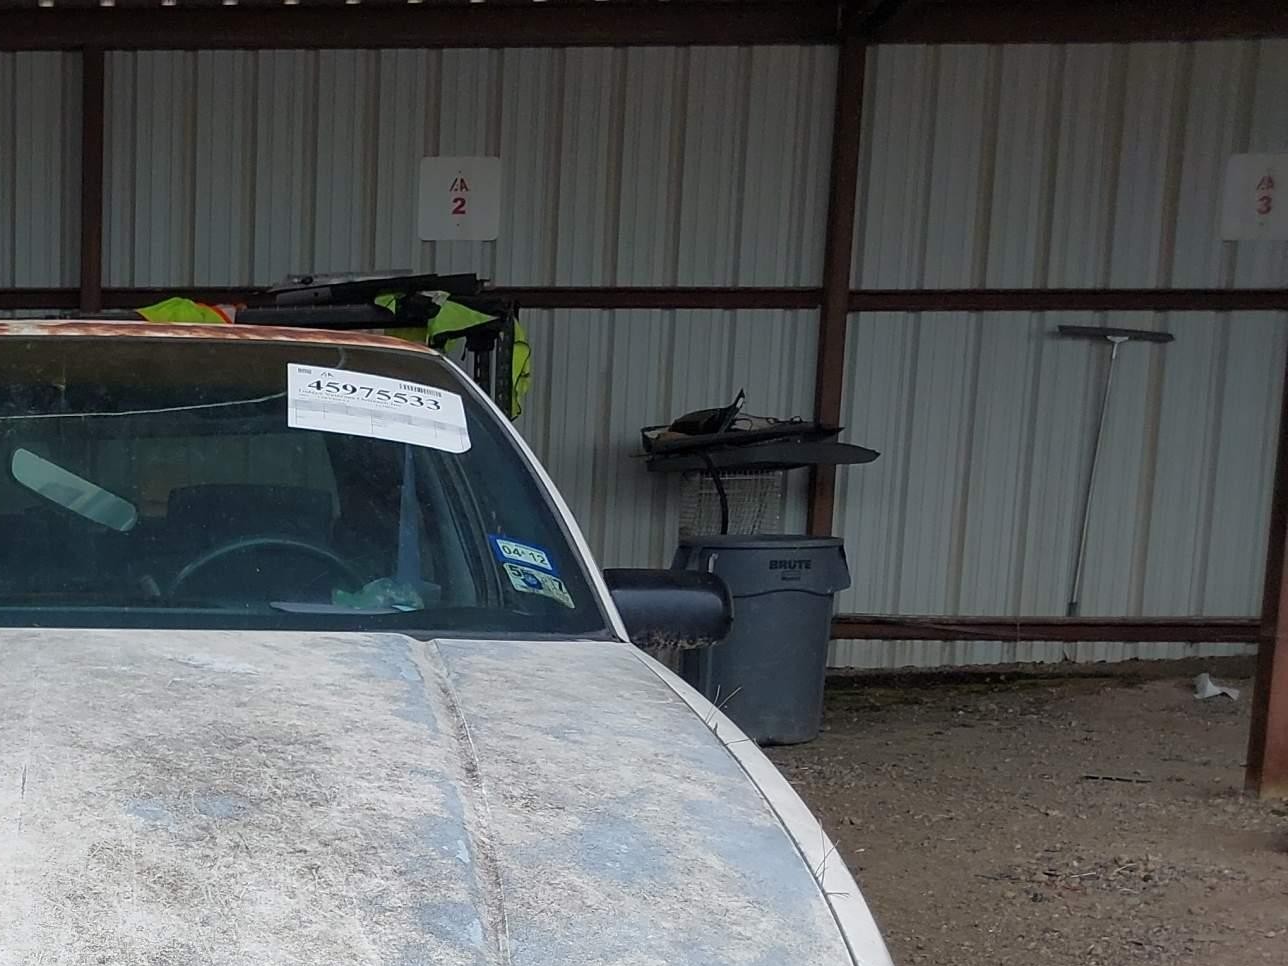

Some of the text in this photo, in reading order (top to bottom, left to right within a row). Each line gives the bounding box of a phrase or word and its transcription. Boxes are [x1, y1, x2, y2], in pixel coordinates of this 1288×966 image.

[452, 197, 466, 215] 2
[1257, 195, 1272, 215] 3
[307, 379, 441, 411] 45975533
[769, 559, 812, 570] BRUTE
